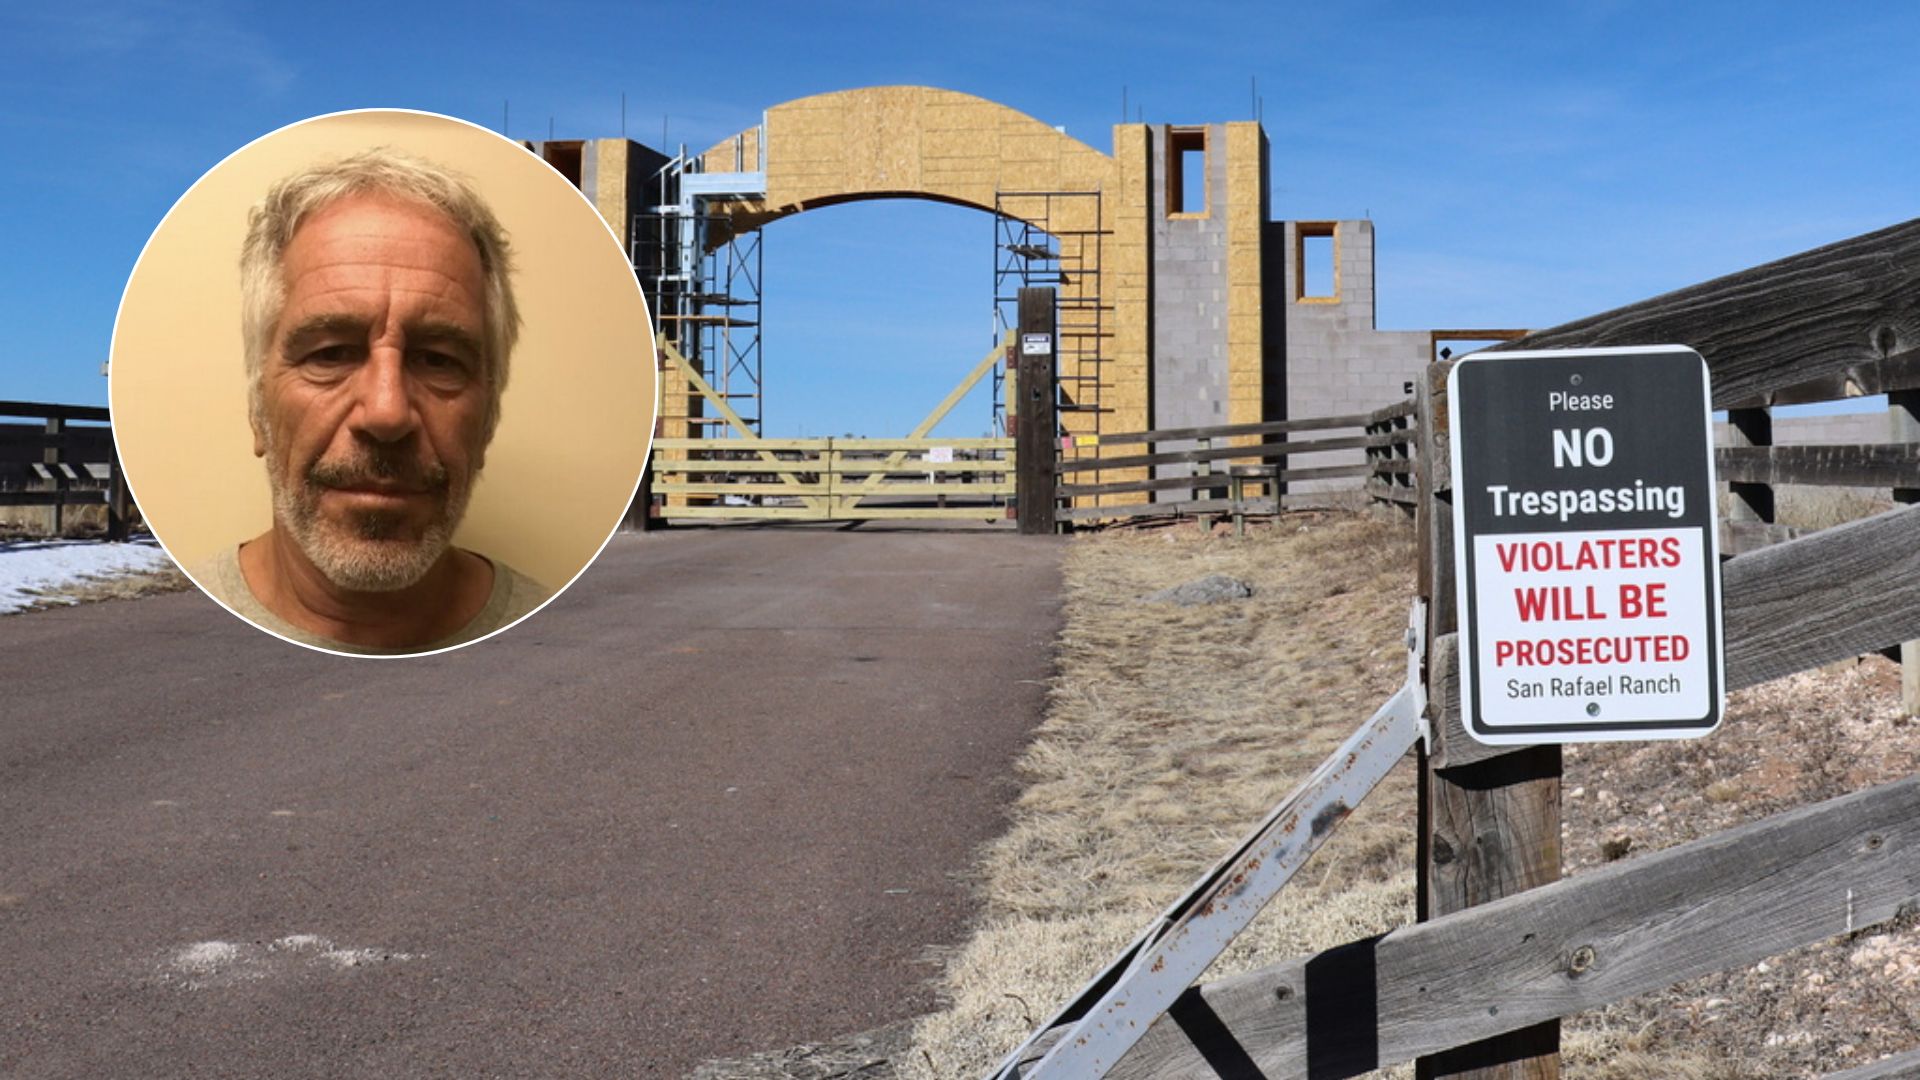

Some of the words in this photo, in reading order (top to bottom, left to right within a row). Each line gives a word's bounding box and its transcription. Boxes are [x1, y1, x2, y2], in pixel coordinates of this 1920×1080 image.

[1549, 391, 1614, 411] Please
[1553, 427, 1614, 468] NO
[1487, 480, 1685, 521] Trespassing
[1496, 537, 1681, 572] VIOLATERS
[1515, 585, 1607, 622] WILL
[1620, 583, 1667, 618] BE
[1495, 635, 1689, 667] PROSECUTED
[1507, 679, 1544, 698] San
[1551, 675, 1613, 696] Rafael
[1621, 674, 1680, 694] Ranch
